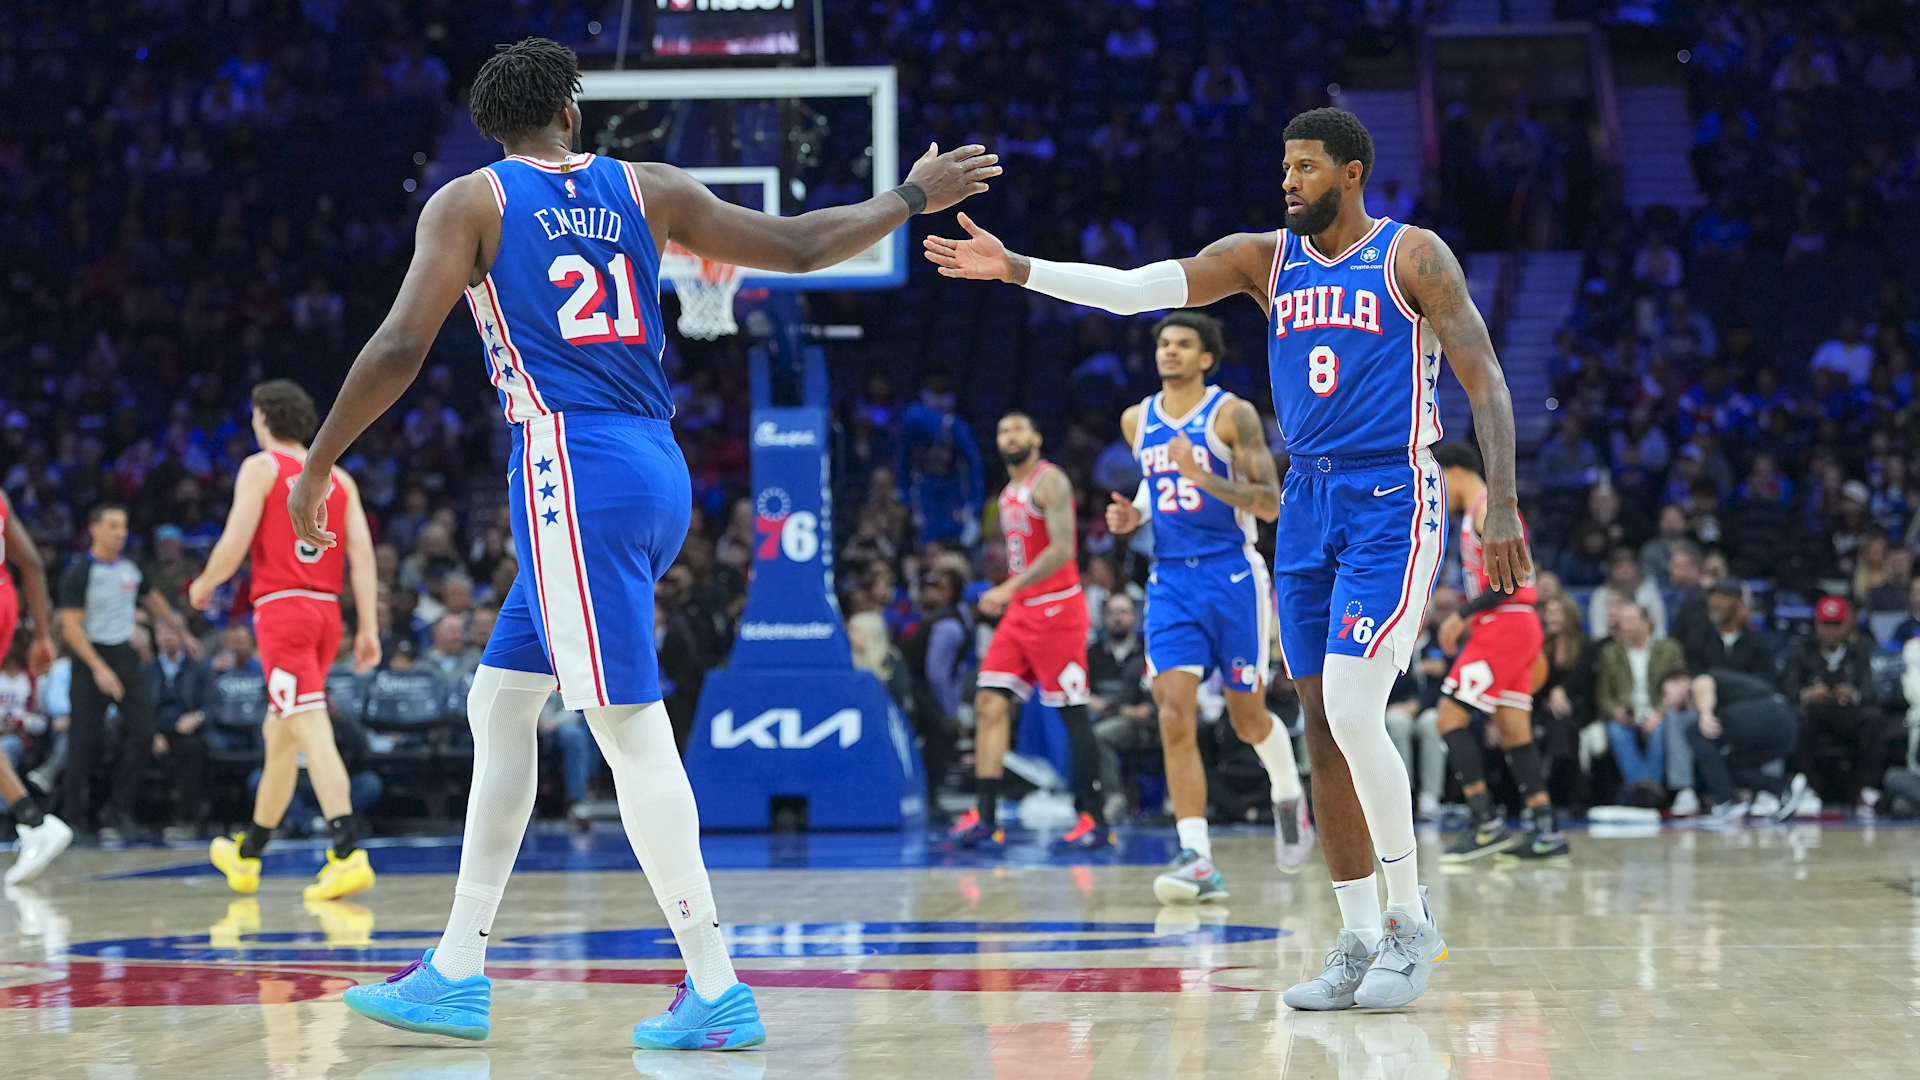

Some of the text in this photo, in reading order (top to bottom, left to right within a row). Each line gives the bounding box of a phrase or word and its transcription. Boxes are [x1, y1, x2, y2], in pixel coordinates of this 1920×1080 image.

[534, 207, 622, 243] EMBIID
[548, 253, 646, 346] 21
[1274, 286, 1383, 339] PHILA
[1309, 345, 1339, 397] 8
[1140, 443, 1214, 478] PHA
[1156, 477, 1203, 513] 25
[756, 510, 819, 562] 76
[1337, 614, 1375, 644] 76
[710, 708, 862, 749] KIA
